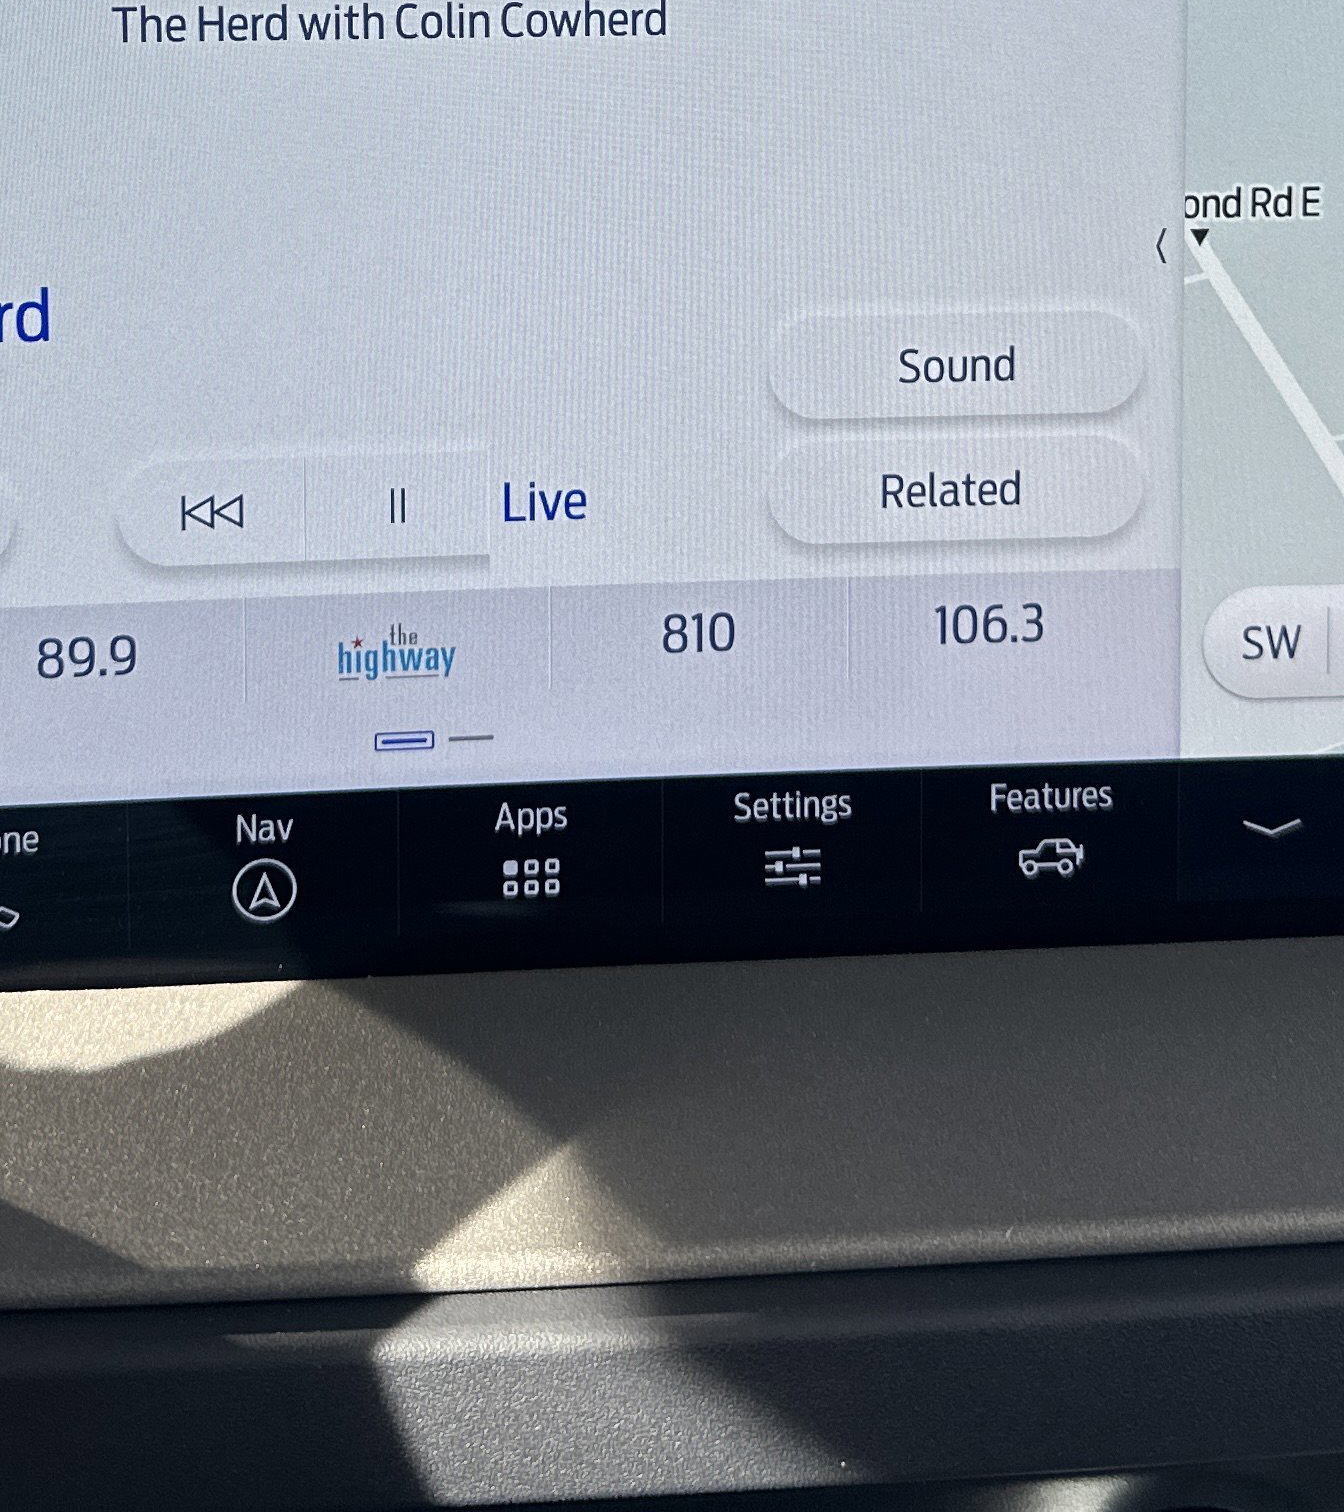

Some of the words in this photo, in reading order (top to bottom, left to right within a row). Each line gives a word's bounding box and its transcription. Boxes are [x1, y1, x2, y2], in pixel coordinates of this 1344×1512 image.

[111, 4, 187, 43] The
[198, 3, 288, 42] Herd
[297, 2, 385, 41] with
[395, 1, 491, 40] Colin
[1251, 185, 1293, 218] Rd
[1302, 186, 1321, 217] E
[898, 345, 1016, 384] Sound
[503, 481, 587, 523] Live
[881, 469, 1021, 509] Related
[389, 622, 418, 646] the
[662, 611, 735, 654] 810
[934, 602, 1045, 645] 106.3
[1242, 624, 1302, 661] SW
[37, 634, 137, 680] 89.9
[338, 639, 456, 681] highway
[733, 790, 853, 823] Settings
[990, 781, 1114, 814] Features
[236, 813, 294, 844] Nav
[494, 801, 568, 836] Apps
